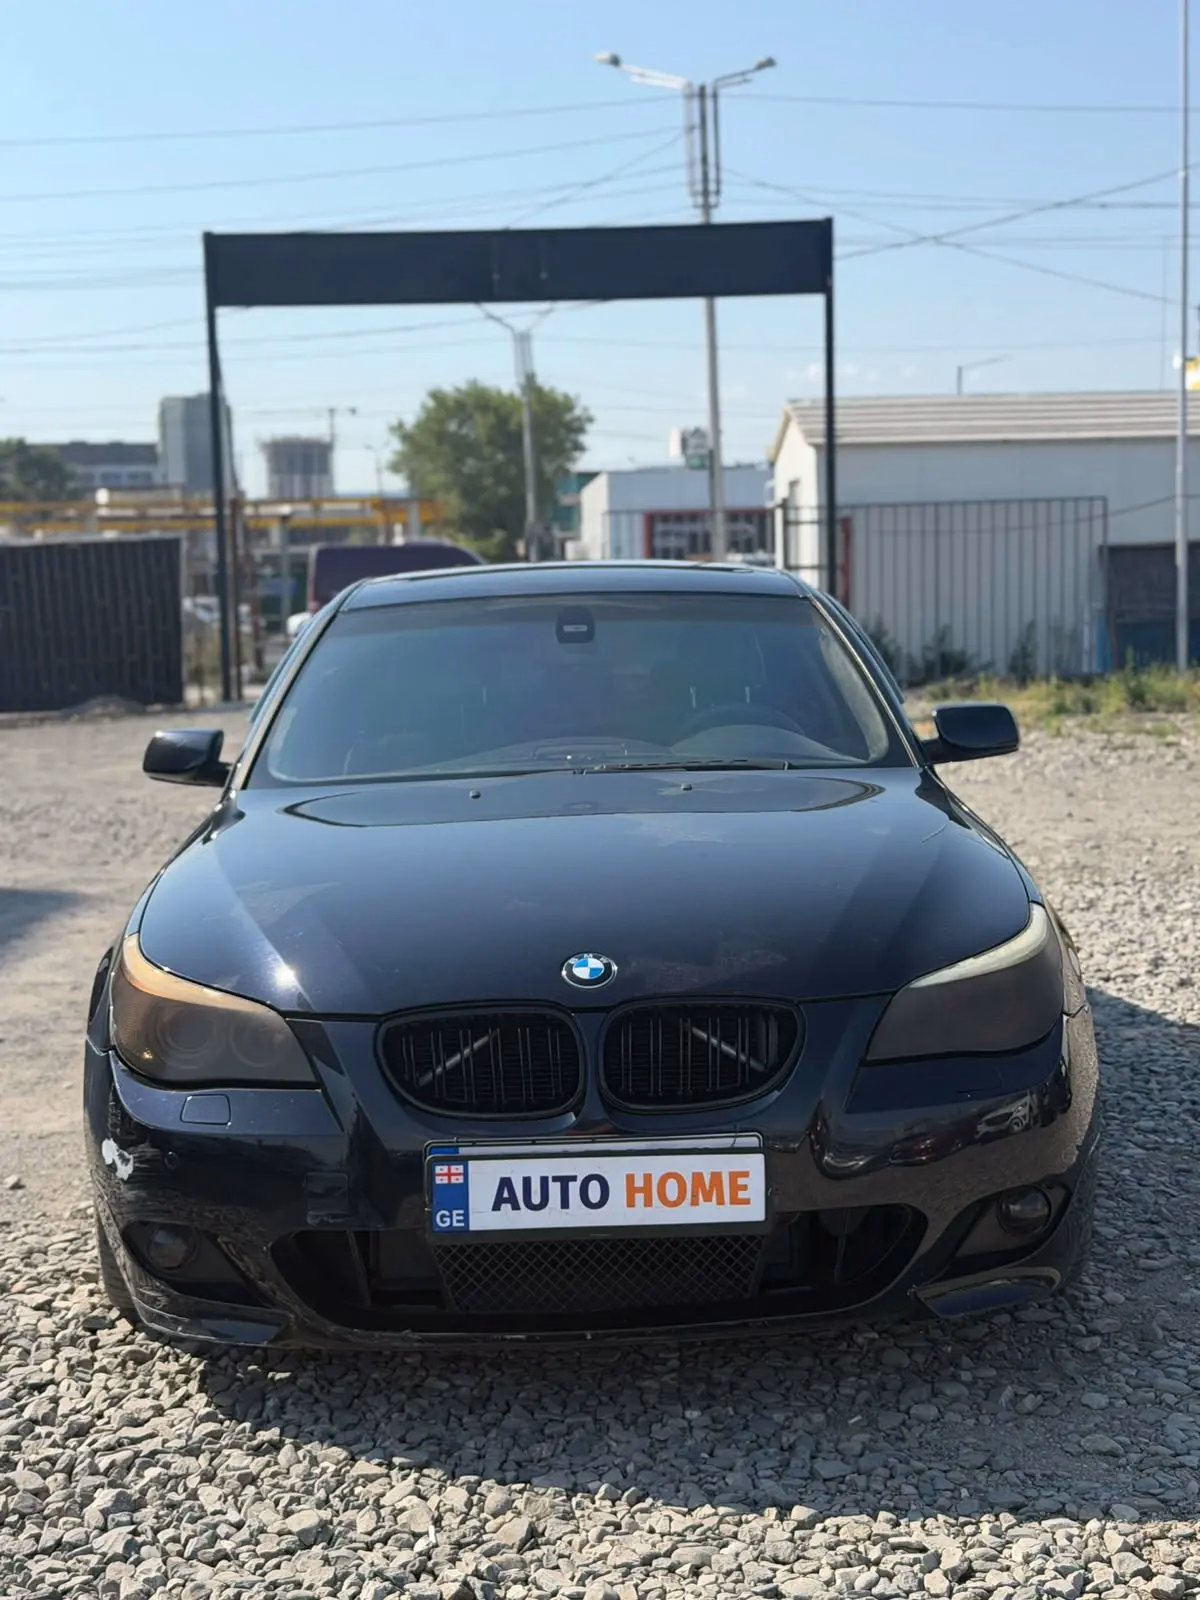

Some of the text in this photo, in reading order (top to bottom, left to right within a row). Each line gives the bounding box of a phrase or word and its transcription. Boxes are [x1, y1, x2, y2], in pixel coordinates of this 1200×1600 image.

[492, 1171, 752, 1212] AUTO HOME
[435, 1209, 465, 1228] GE
